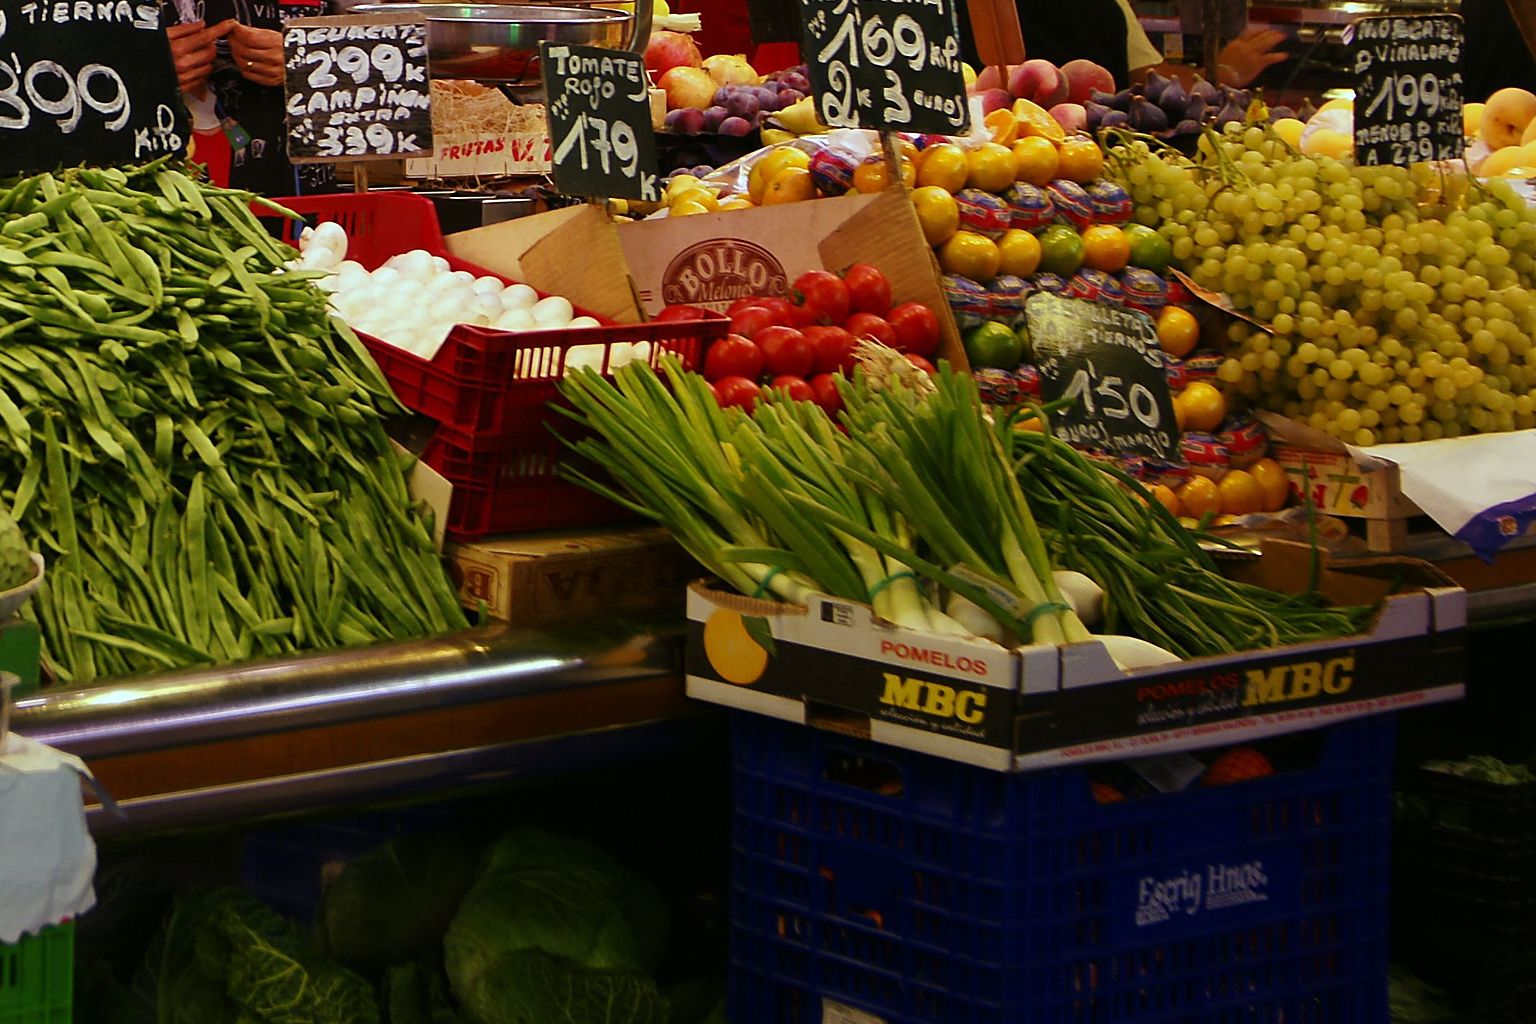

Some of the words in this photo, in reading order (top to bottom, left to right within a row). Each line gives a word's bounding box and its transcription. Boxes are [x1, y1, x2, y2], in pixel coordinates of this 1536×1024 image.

[440, 137, 505, 160] FRUTAS
[680, 248, 766, 295] BOLLO
[881, 640, 987, 676] POMELOS
[1136, 672, 1240, 703] POMELOS
[1242, 656, 1355, 707] MBC
[879, 672, 987, 724] MBC
